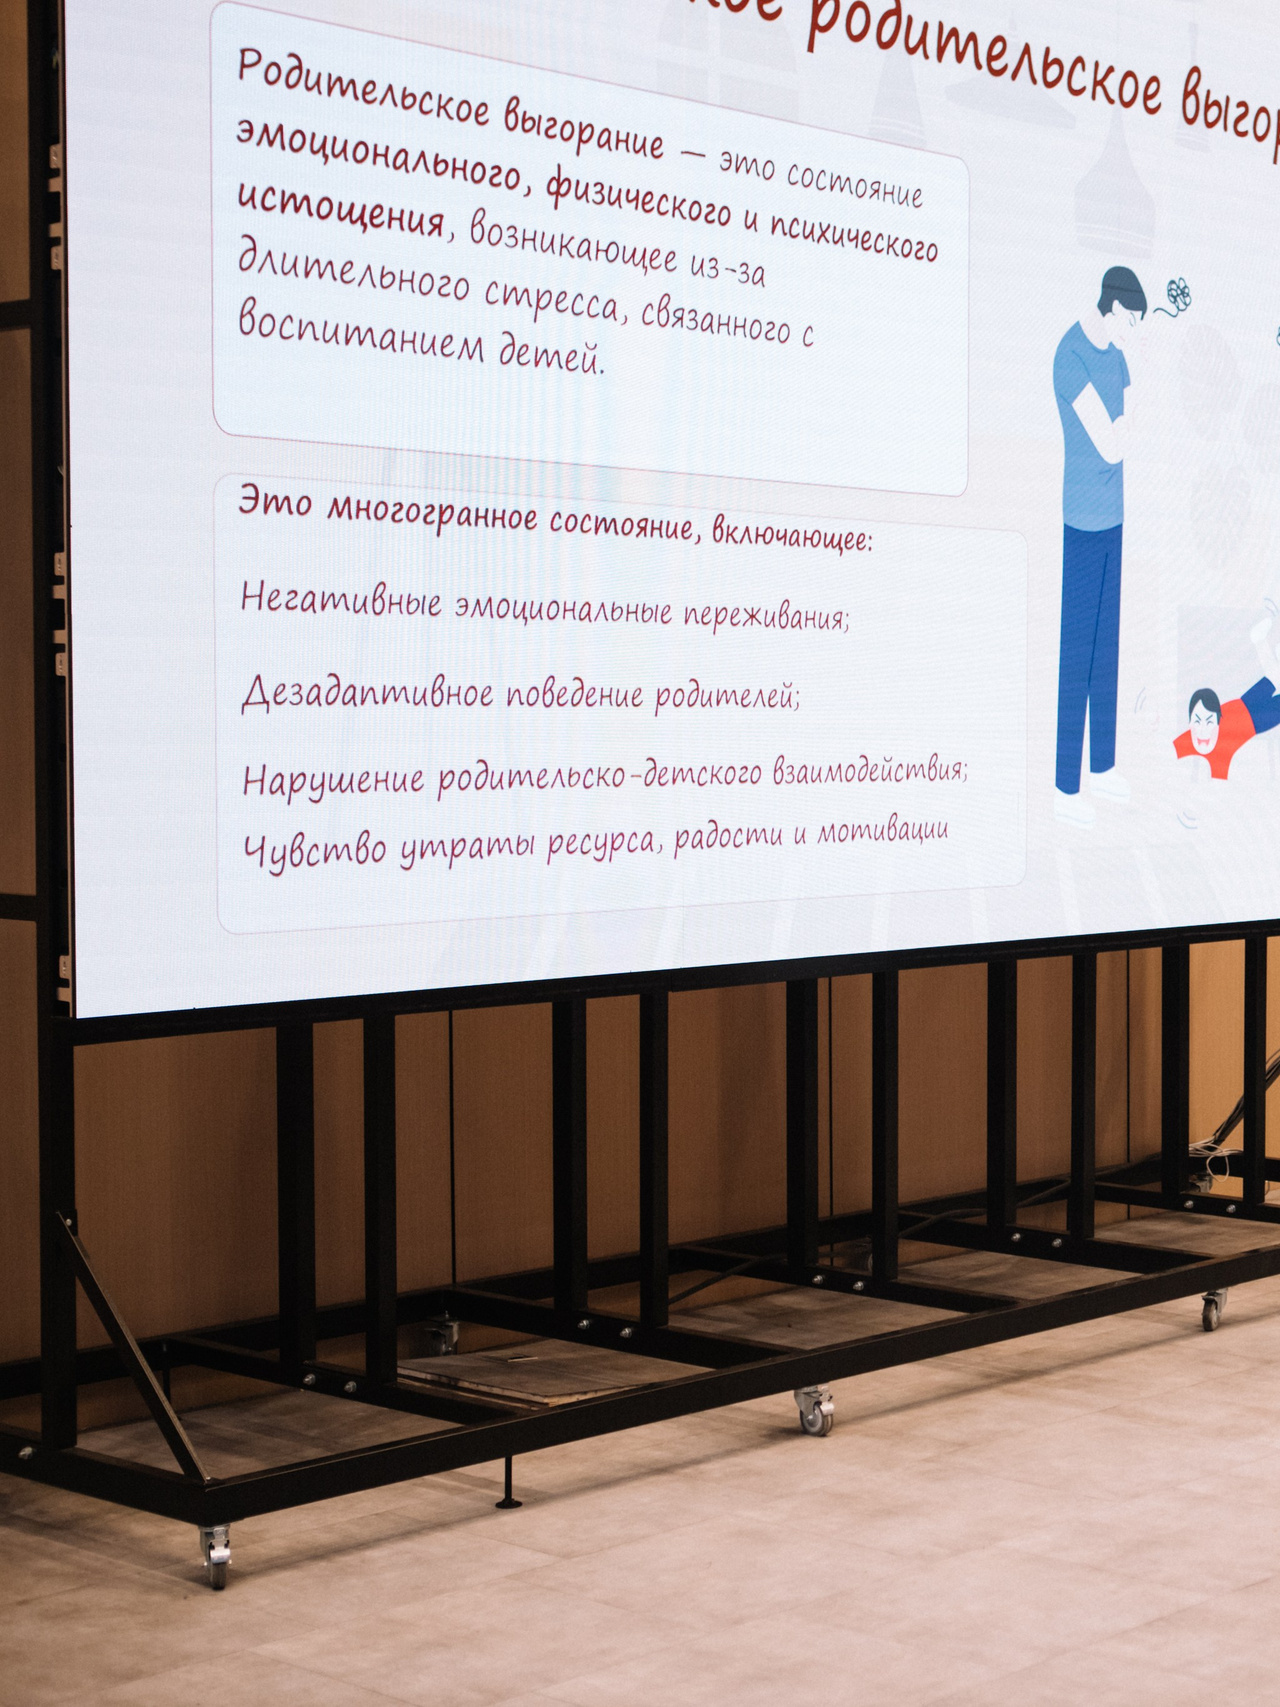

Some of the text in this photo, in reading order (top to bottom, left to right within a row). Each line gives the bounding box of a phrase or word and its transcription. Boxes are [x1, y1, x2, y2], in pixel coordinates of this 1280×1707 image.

[806, 0, 1162, 116] родительское
[238, 47, 490, 127] Родительское
[503, 94, 665, 160] выгорание
[719, 150, 776, 181] это
[787, 163, 923, 209] состояние
[235, 118, 939, 263] эмоционального, физического и психического
[237, 182, 766, 289] истощения, возникающее из-за
[238, 233, 814, 348] длительного стресса, связанного с
[238, 295, 605, 376] воспитанием детей.
[238, 481, 873, 558] Это многогранное состояние, включающее:
[241, 579, 849, 636] Негативные эмоциональные переживания;
[240, 672, 800, 718] Дезадаптивное поведение родителей;
[243, 752, 968, 807] Нарушение родительско-детского взаимодействия;
[244, 811, 948, 878] Чувство утраты ресурса, радости и мотивации
